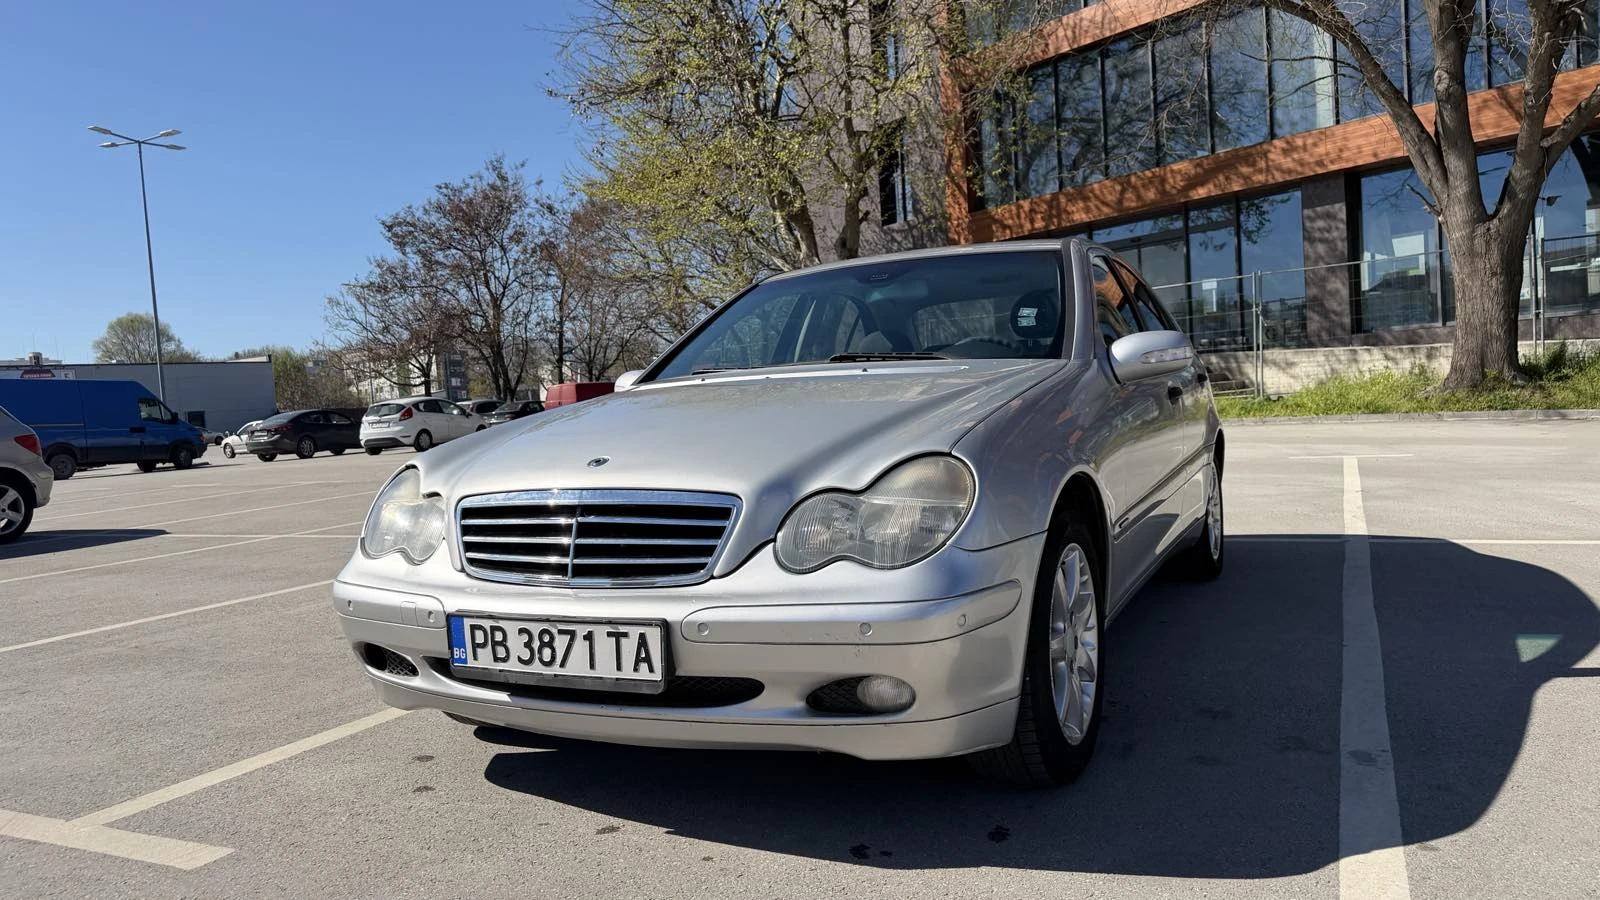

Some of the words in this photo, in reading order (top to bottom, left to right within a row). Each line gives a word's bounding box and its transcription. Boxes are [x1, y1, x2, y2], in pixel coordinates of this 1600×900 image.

[453, 647, 466, 659] BG
[469, 623, 510, 663] PB
[517, 627, 596, 670] 3871
[606, 630, 655, 673] TA
